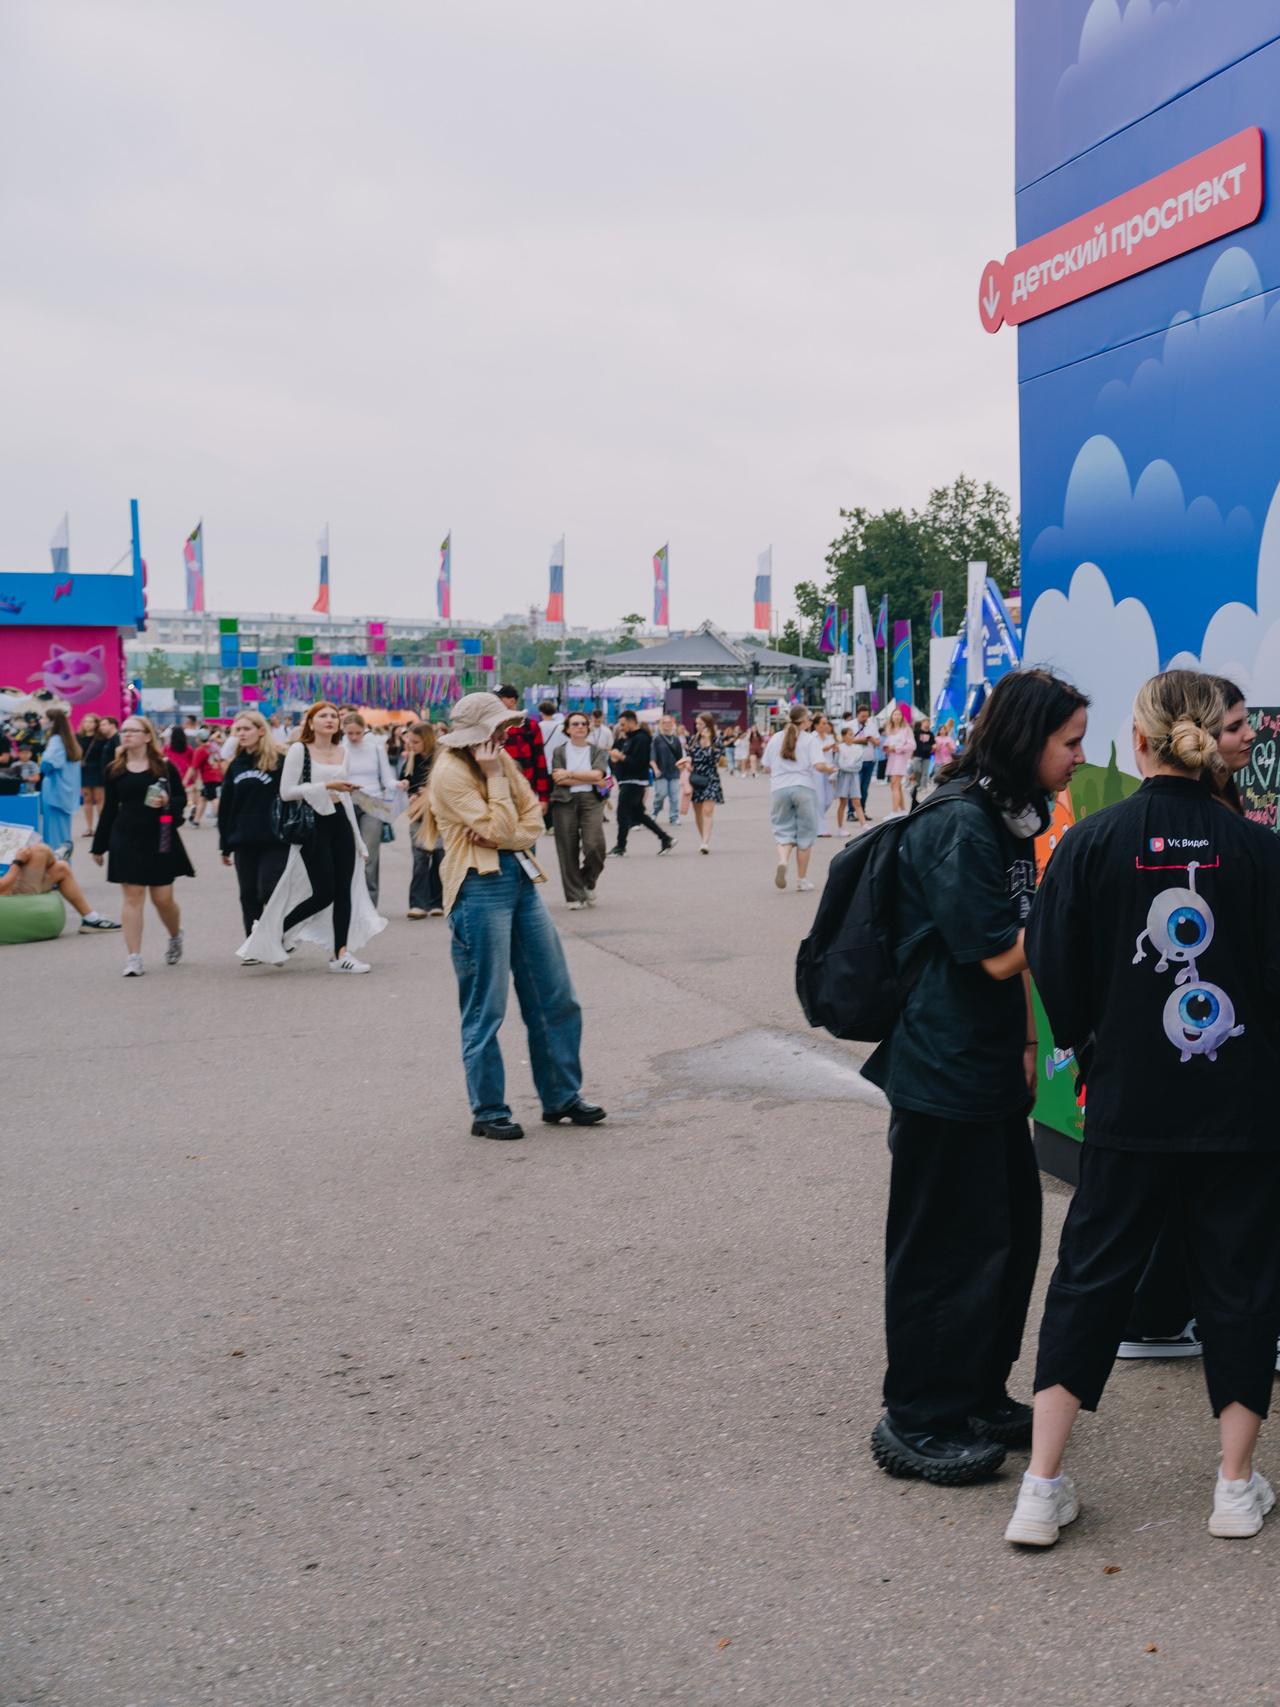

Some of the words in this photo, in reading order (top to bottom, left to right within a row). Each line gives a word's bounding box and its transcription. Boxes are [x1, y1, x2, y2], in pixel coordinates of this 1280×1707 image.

[1011, 222, 1108, 306] детский
[1111, 162, 1247, 256] проспект
[1167, 838, 1181, 847] VK
[1182, 838, 1209, 848] Видео
